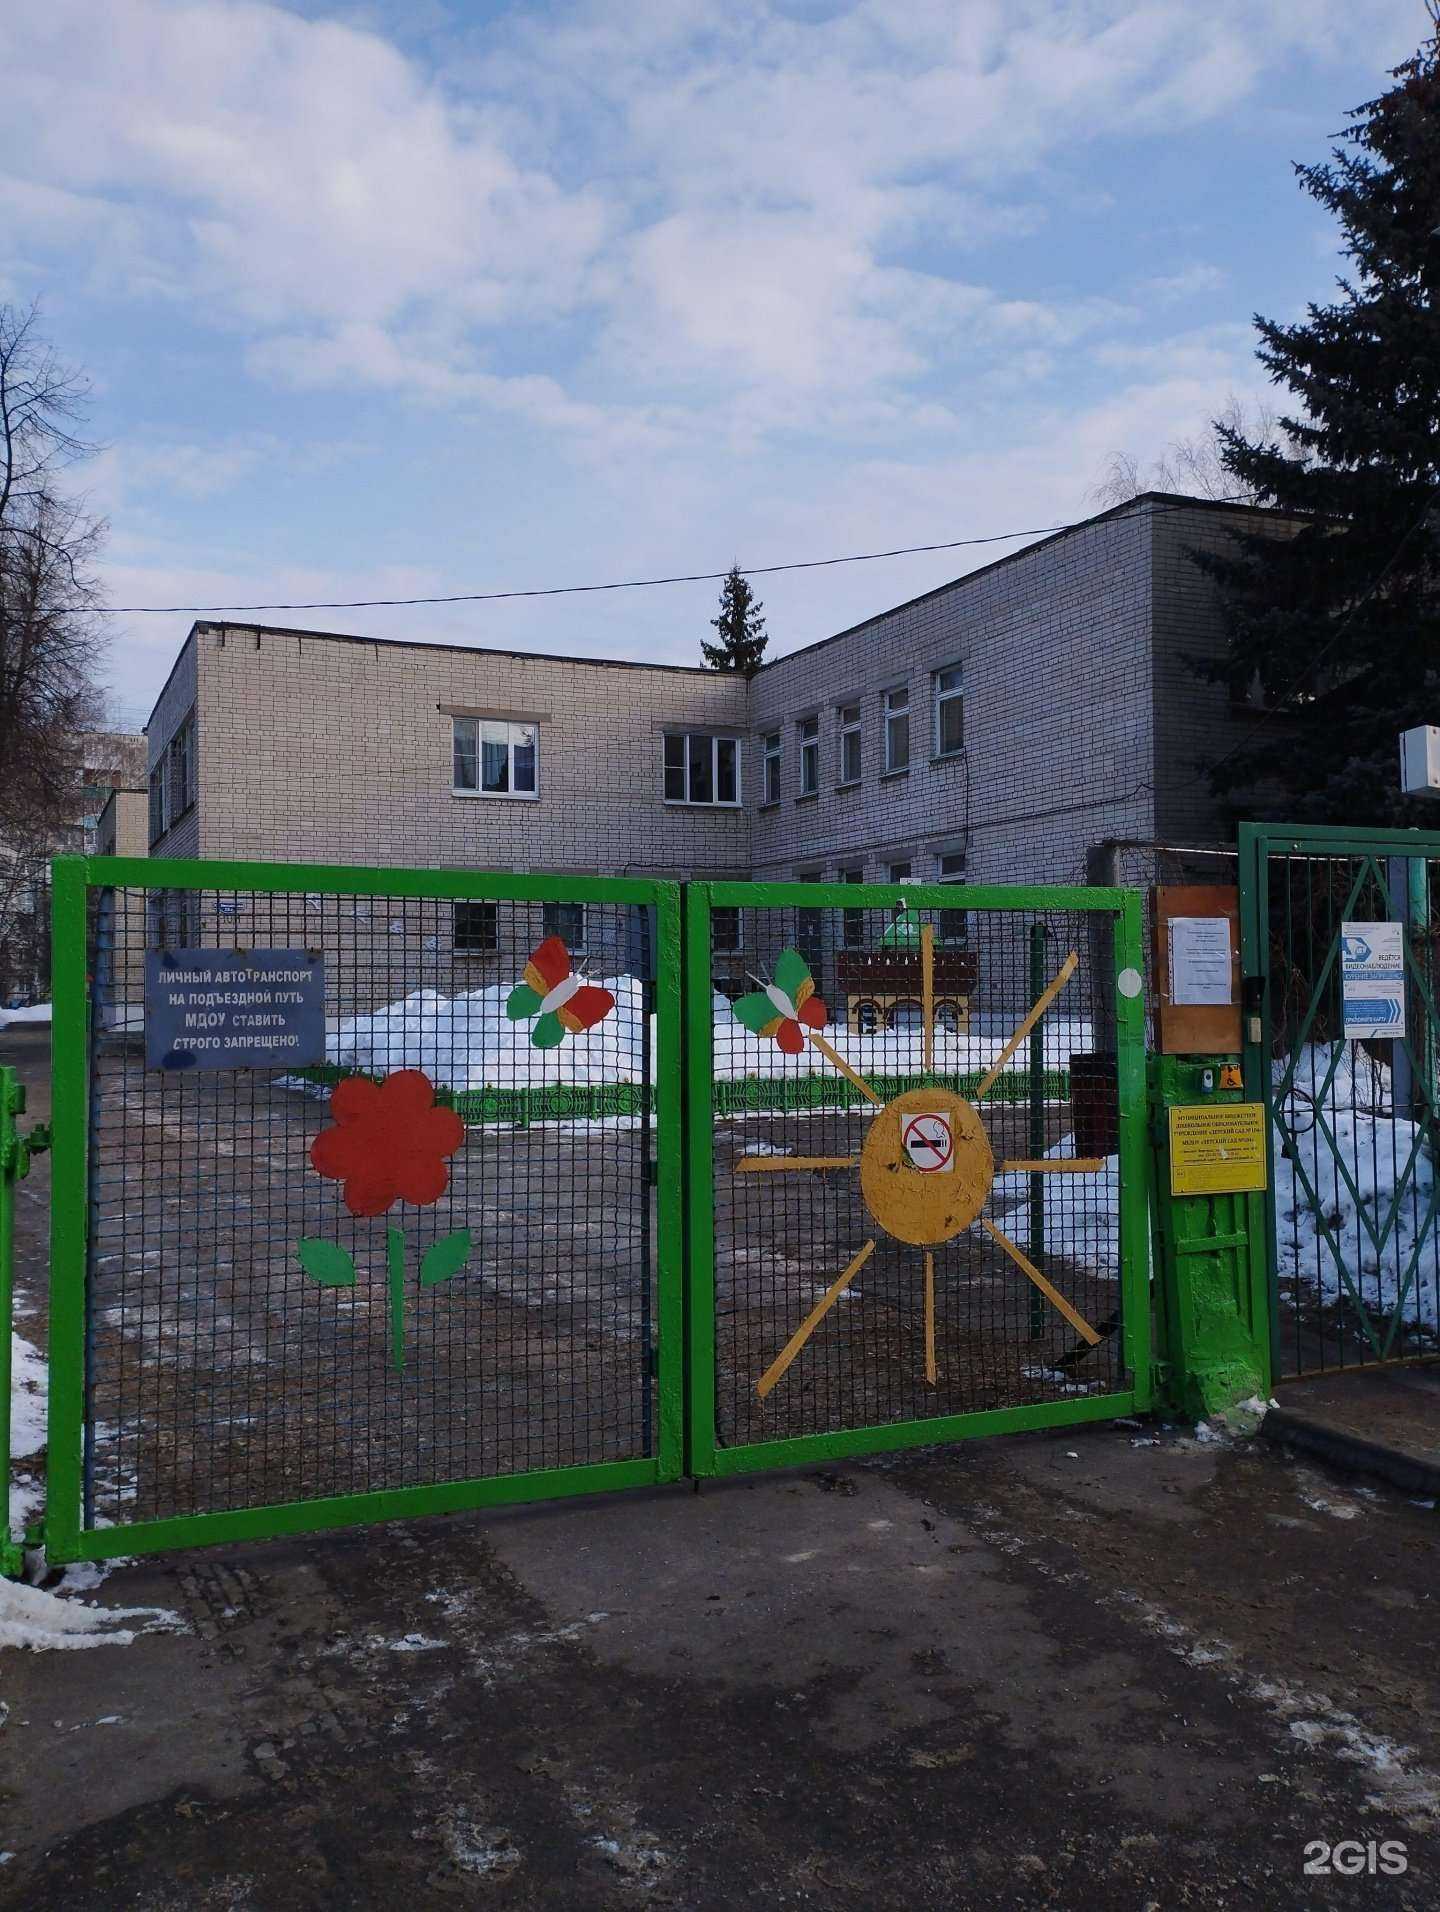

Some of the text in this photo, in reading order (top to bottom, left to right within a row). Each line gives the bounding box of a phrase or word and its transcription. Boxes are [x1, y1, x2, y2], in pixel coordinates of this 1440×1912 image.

[158, 968, 313, 983] ЛИЧНЫЙ АВТОТРАНСПОРТ
[169, 989, 304, 1007] НА ПОДЪЕЗДНОЙ ПУТЬ
[185, 1013, 286, 1029] МДОУ СТАВИТЬ
[173, 1035, 300, 1050] СТРОГО ЗАПРЕЩЕНО!
